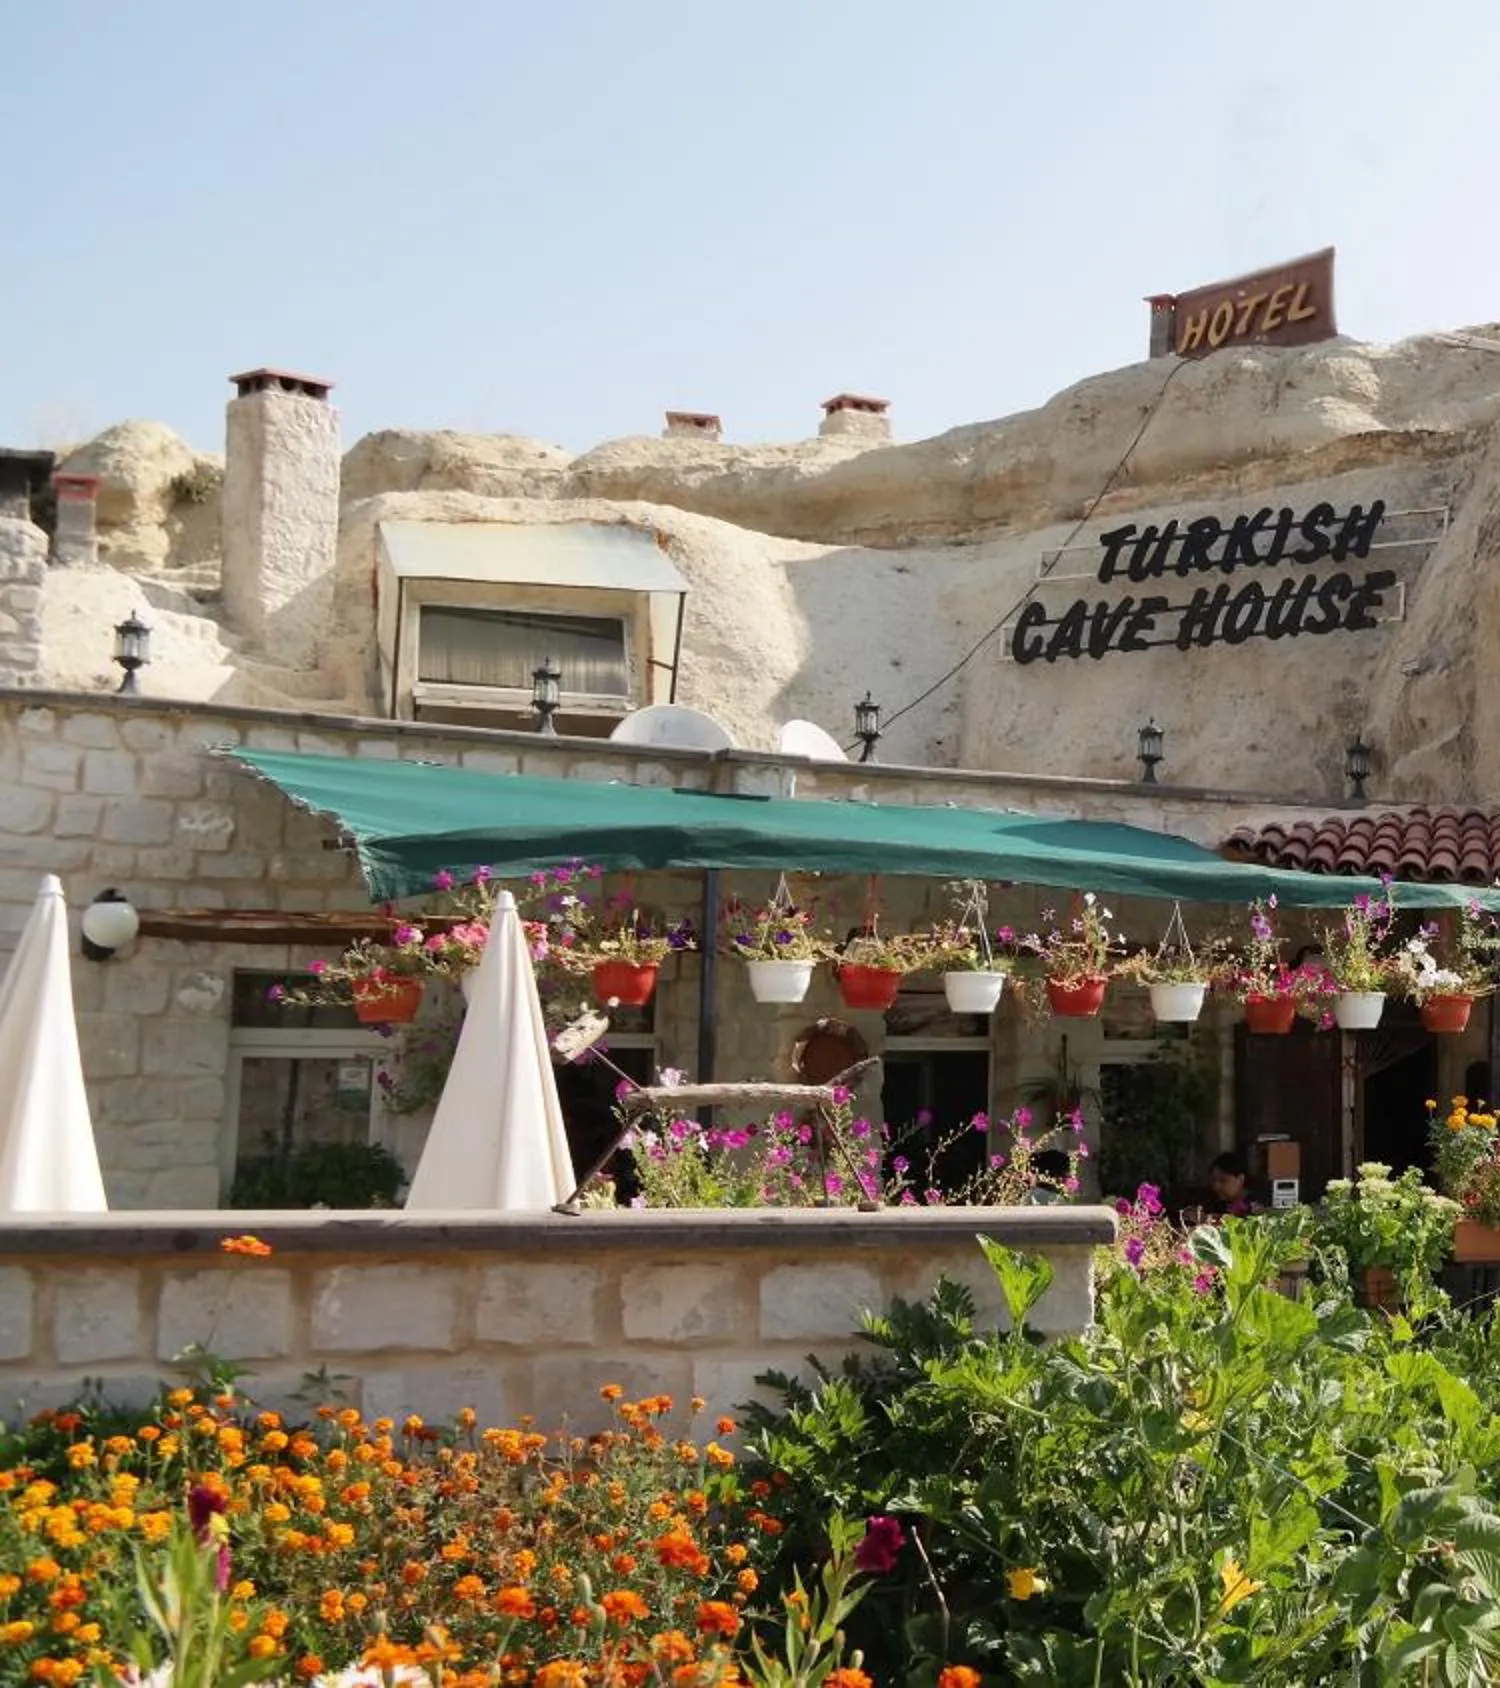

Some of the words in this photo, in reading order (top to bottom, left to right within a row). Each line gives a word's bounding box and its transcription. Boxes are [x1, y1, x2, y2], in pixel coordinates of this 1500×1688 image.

[1177, 283, 1316, 353] HOTEL
[1098, 500, 1385, 582] TURKISH
[1012, 597, 1169, 664] CAVE
[1176, 570, 1396, 650] HOUSE
